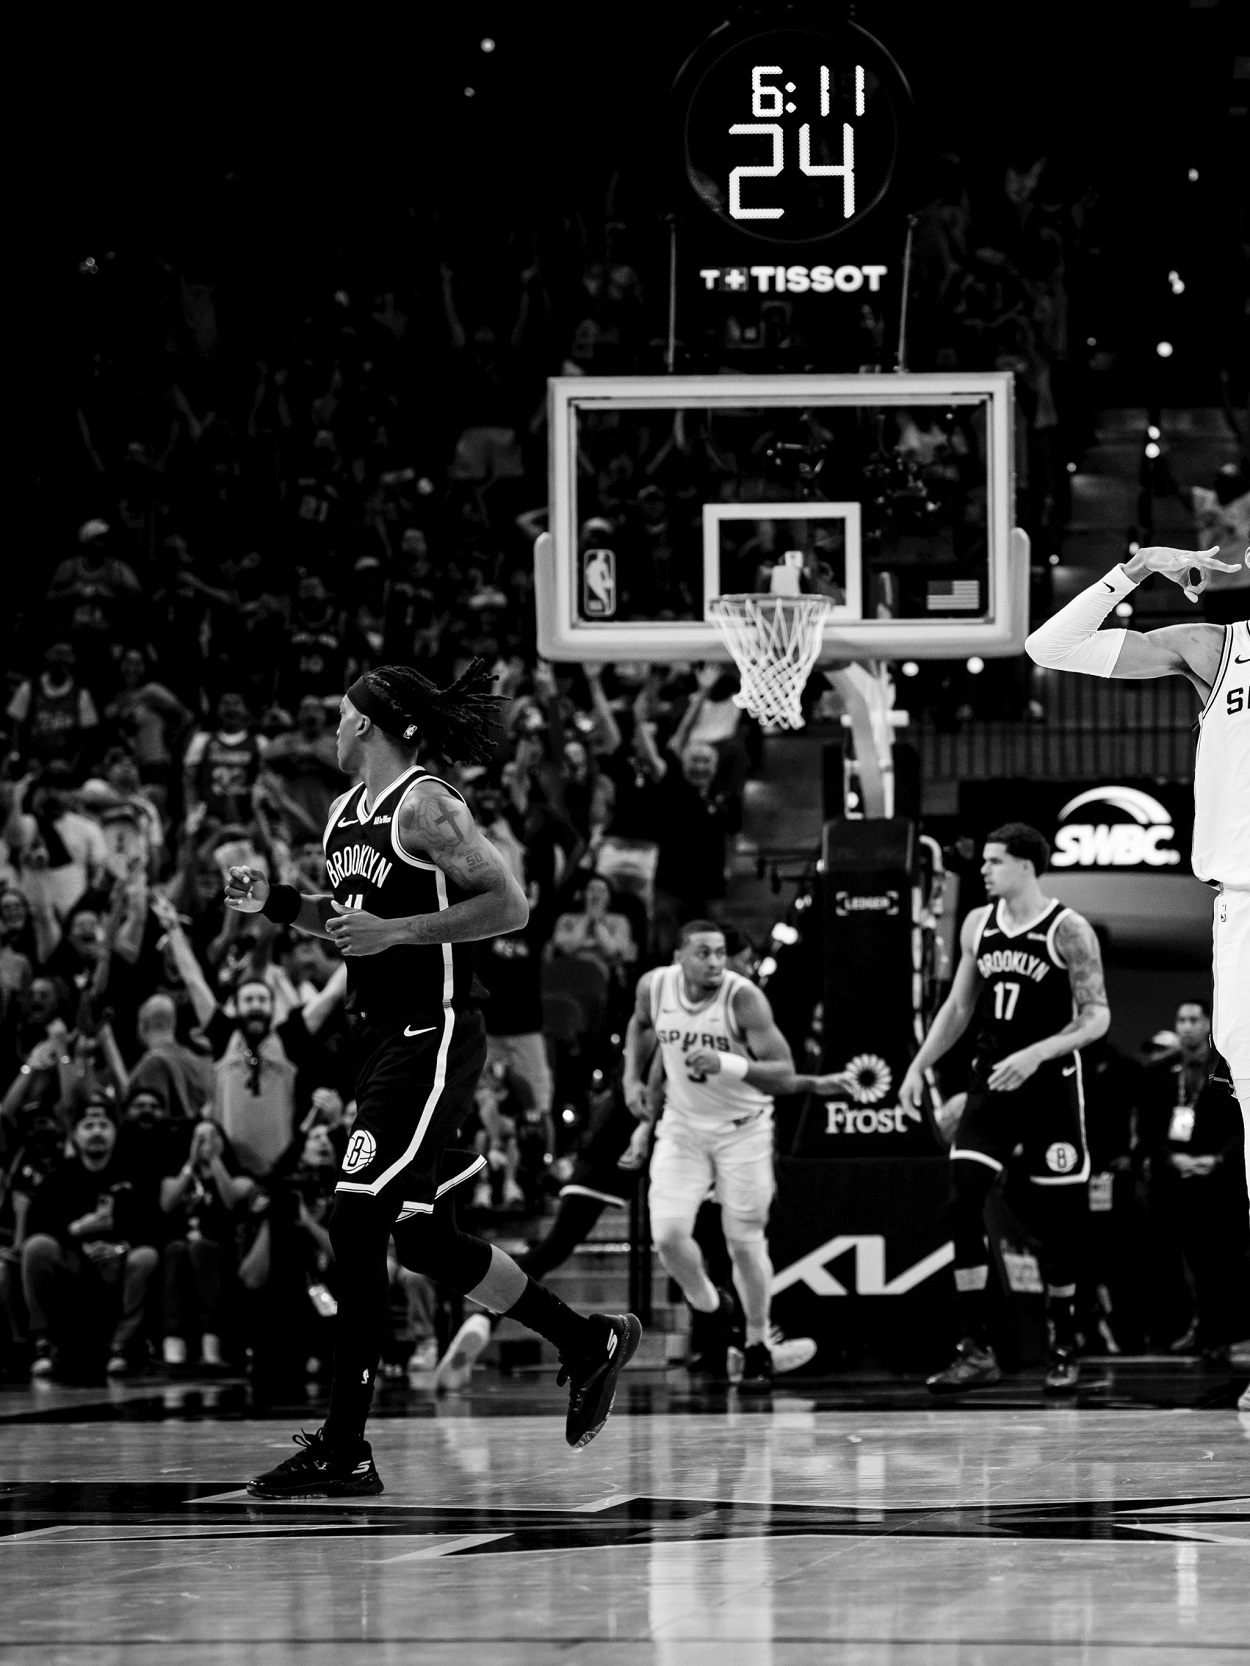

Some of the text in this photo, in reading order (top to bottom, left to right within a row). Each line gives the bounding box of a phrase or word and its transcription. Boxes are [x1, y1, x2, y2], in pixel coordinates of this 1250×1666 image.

[752, 66, 865, 117] 6:11
[729, 123, 855, 219] 24
[751, 265, 887, 293] TISSOT
[1050, 823, 1176, 867] SWBC
[325, 844, 393, 888] BROOKLYN
[977, 949, 1050, 982] BROOKLYN
[993, 981, 1020, 1021] 17
[657, 1030, 730, 1053] SPURS
[825, 1102, 908, 1134] Frost
